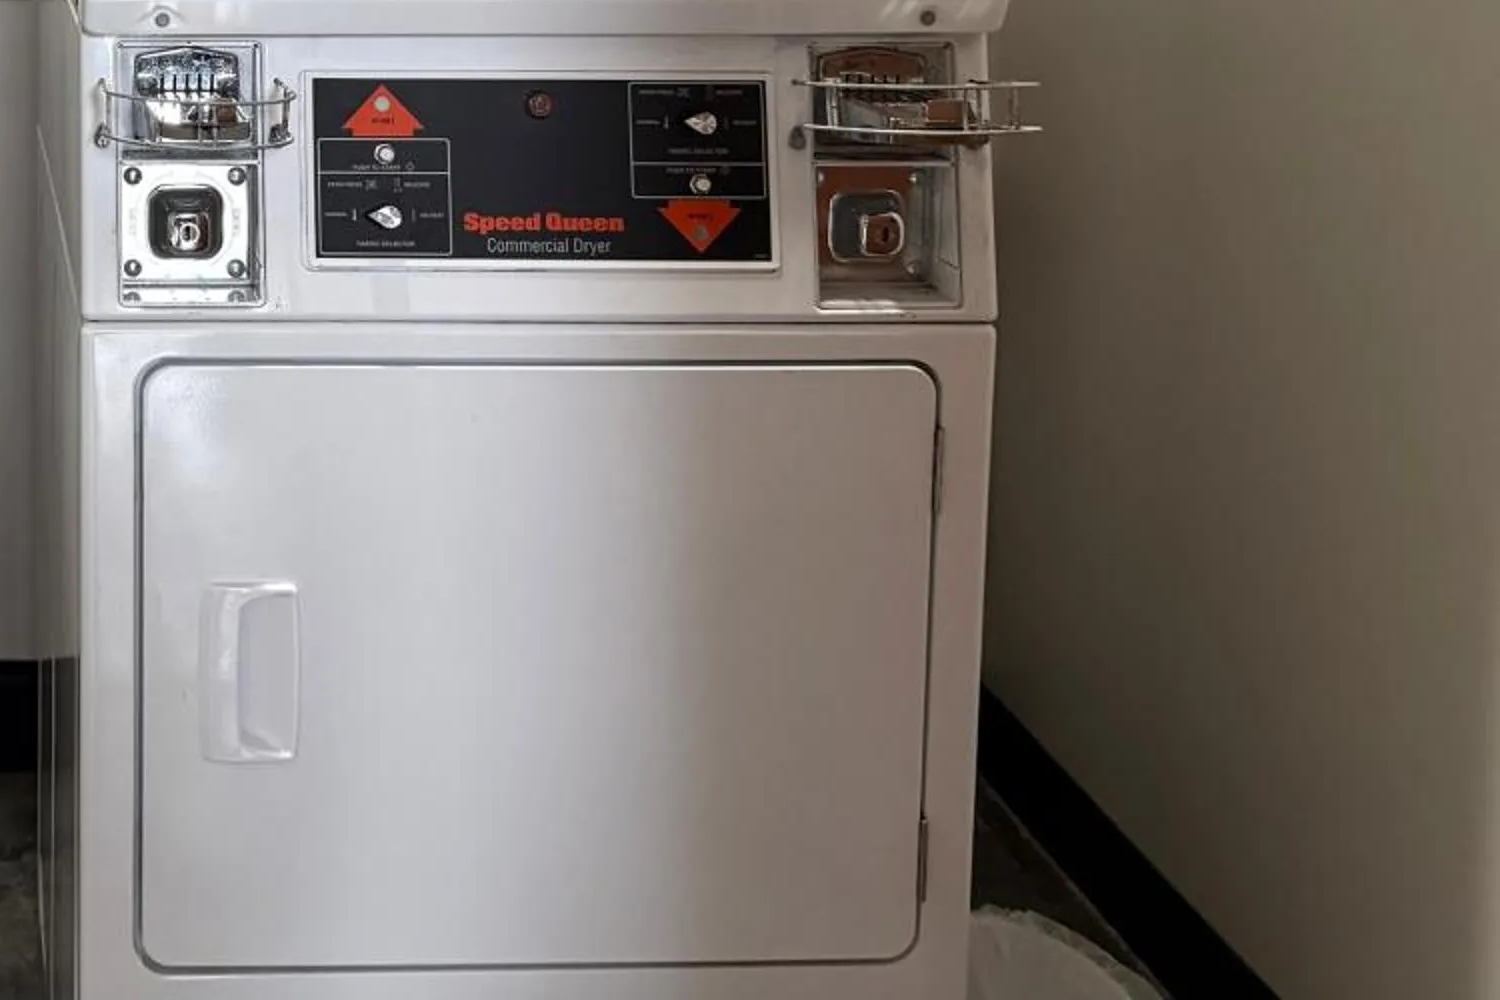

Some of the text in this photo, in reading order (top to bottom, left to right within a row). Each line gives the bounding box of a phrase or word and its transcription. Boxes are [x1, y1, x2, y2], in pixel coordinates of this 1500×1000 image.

[463, 212, 625, 235] Speed Queen
[486, 237, 613, 257] Commercial Dryer
